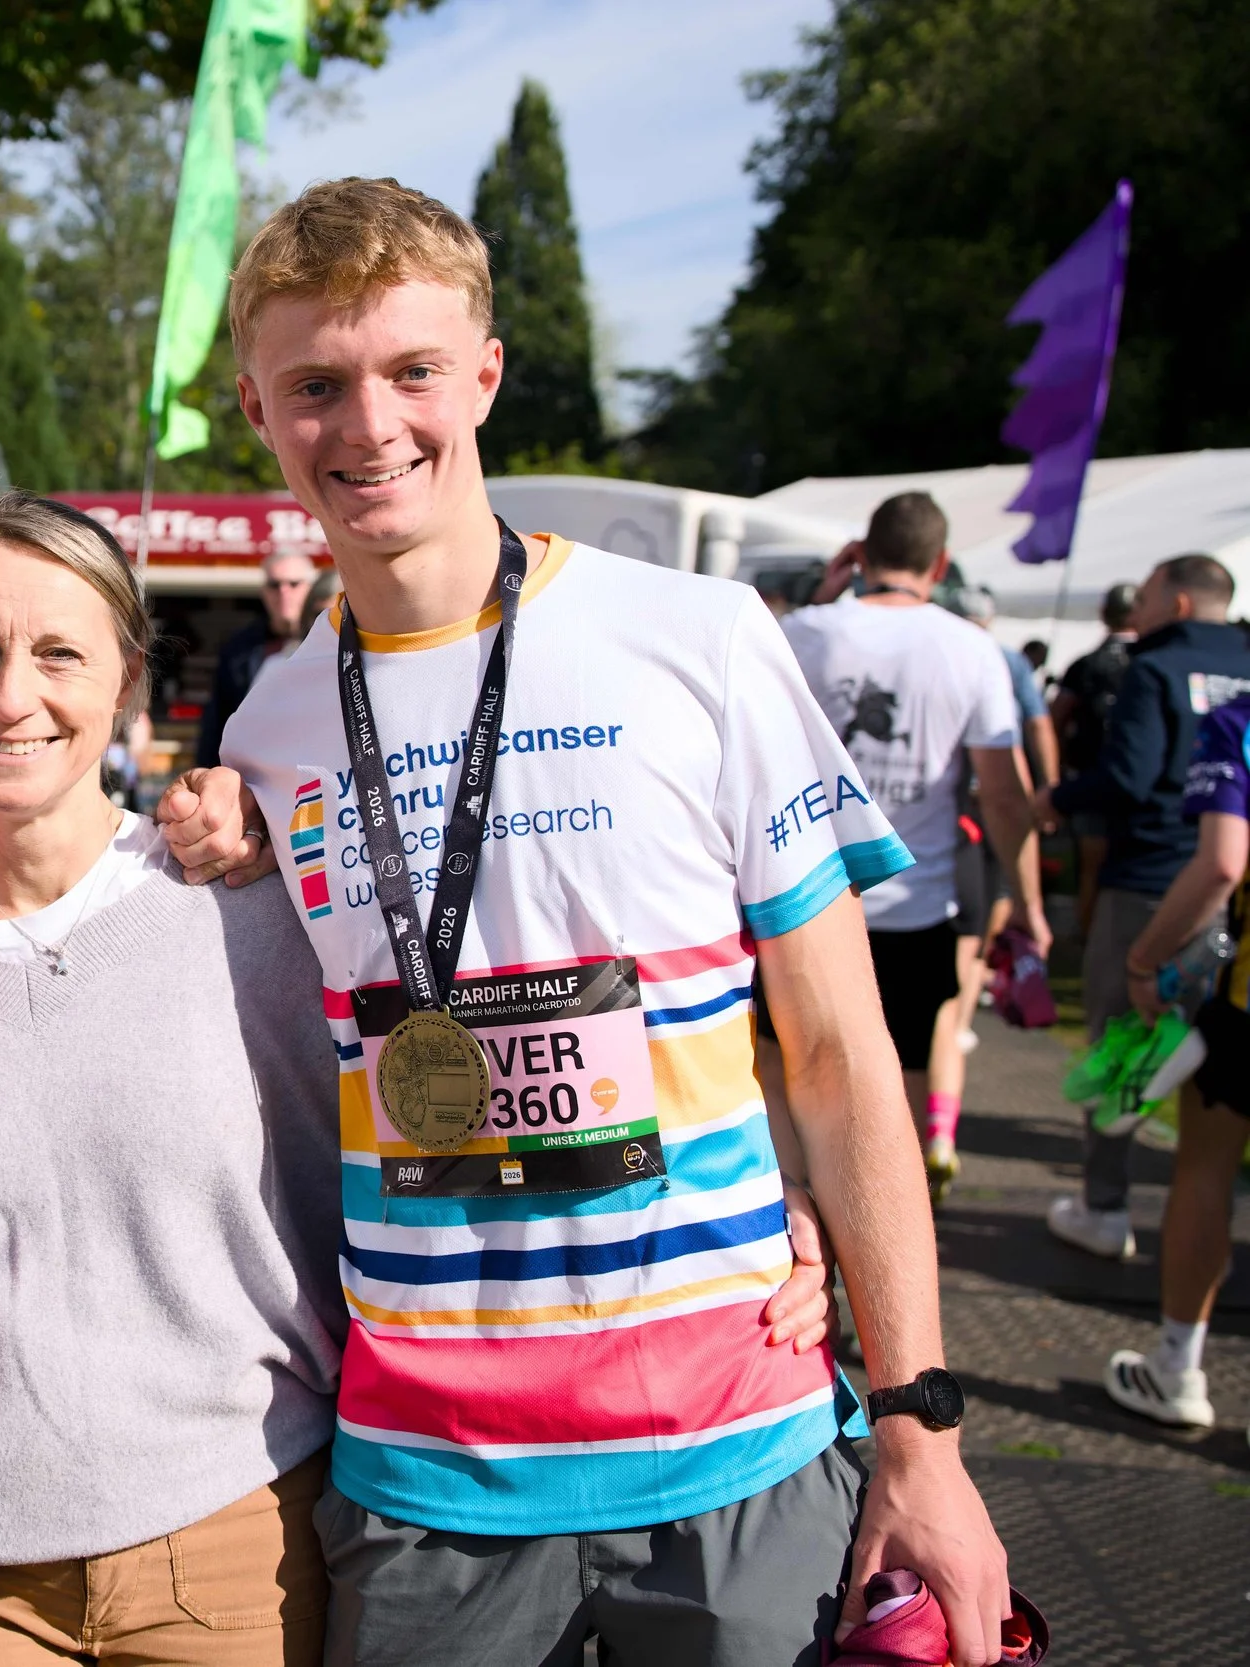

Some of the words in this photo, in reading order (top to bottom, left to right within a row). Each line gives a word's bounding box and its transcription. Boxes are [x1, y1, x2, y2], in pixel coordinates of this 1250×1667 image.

[350, 668, 367, 721] CARDIFF
[358, 721, 375, 756] HALF
[466, 725, 489, 786] CARDIFF
[479, 686, 500, 722] HALF
[336, 730, 469, 800] ychwi
[497, 723, 623, 756] canser
[367, 786, 387, 827] 2026
[765, 773, 874, 852] #TEA
[346, 867, 442, 908] wes
[436, 906, 457, 950] 2026
[406, 938, 432, 1000] CARDIFF
[449, 983, 521, 1006] CARDIFF
[525, 976, 578, 999] HALF
[451, 1008, 483, 1019] HANNER
[484, 1003, 531, 1016] MARATHON
[532, 997, 582, 1012] CAERDYDD
[542, 1133, 583, 1147] UNISEX
[585, 1126, 630, 1143] MEDIUM
[397, 1166, 424, 1182] R4W
